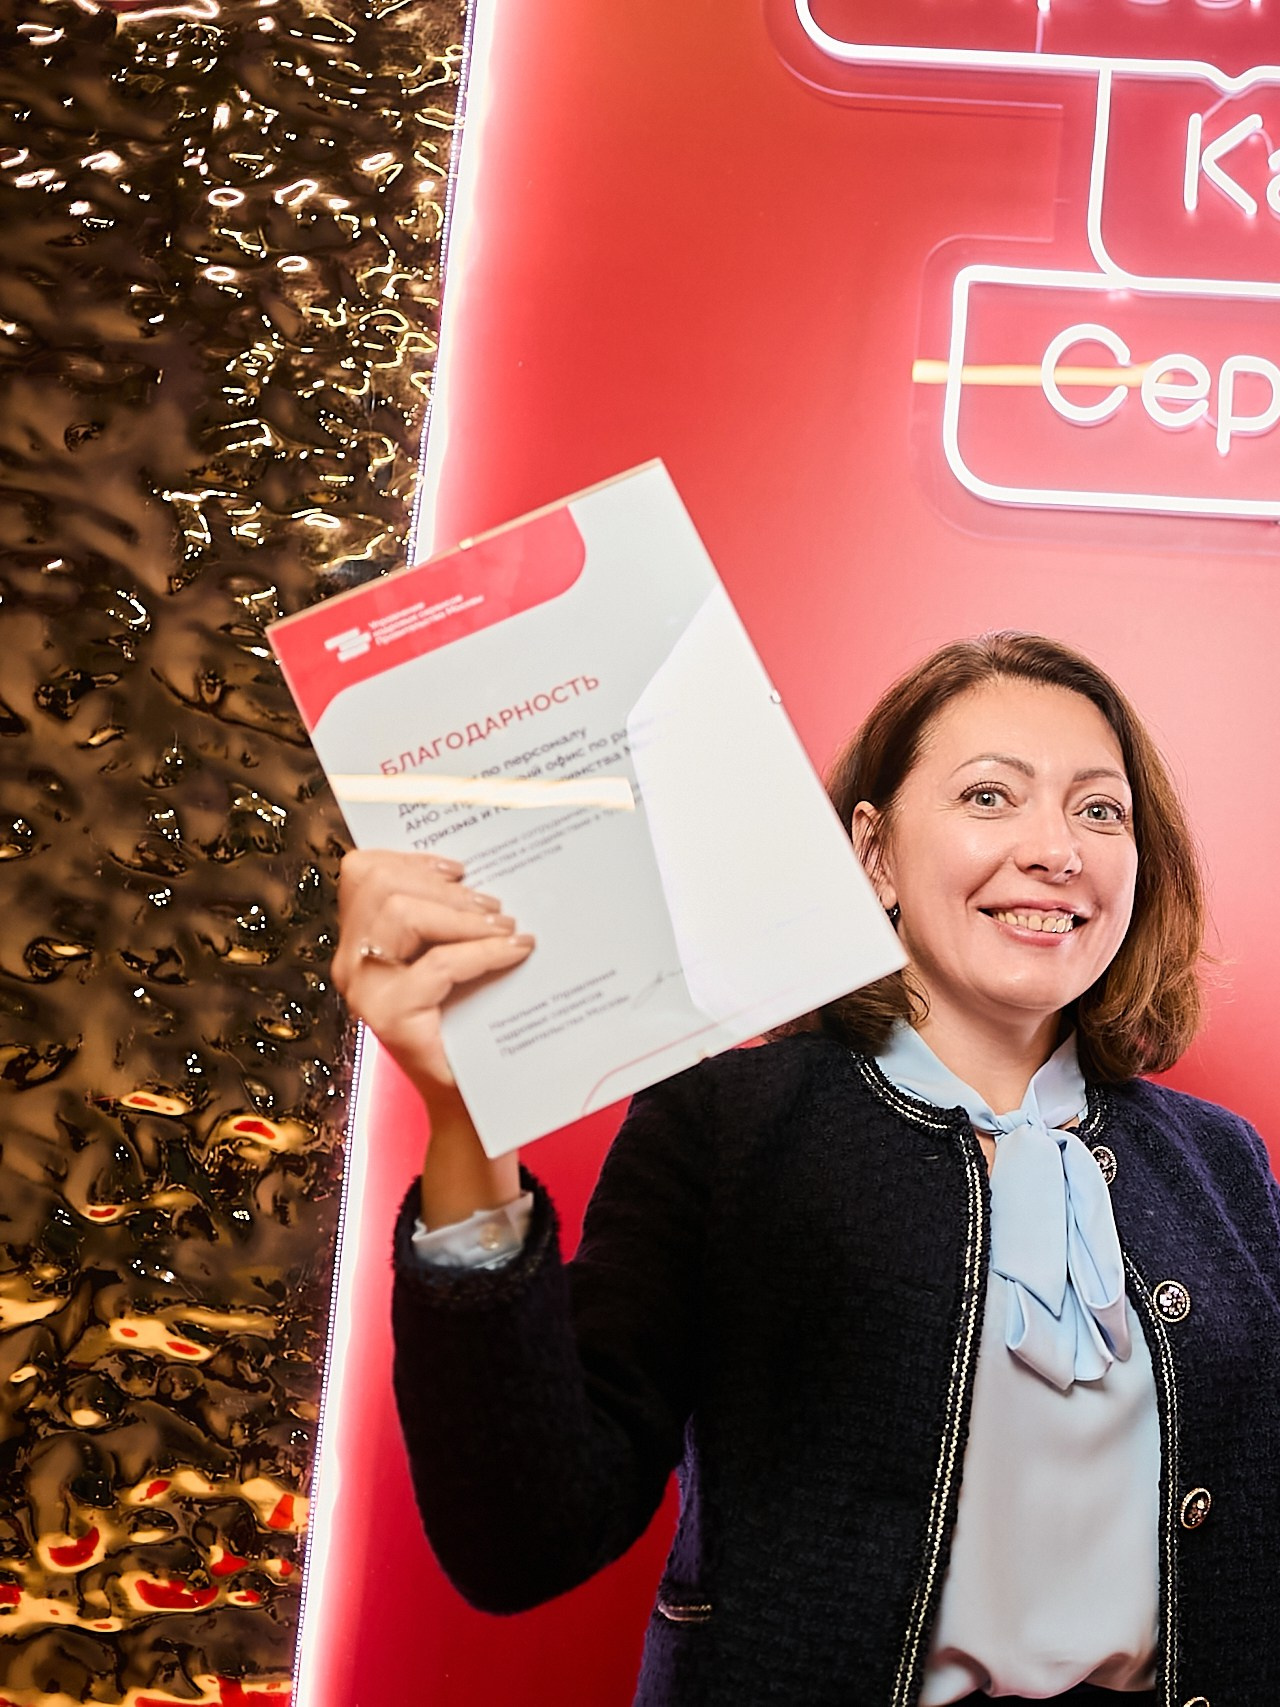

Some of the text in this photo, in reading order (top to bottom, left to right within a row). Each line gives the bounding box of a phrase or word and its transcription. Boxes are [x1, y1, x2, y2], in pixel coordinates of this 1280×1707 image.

[379, 674, 600, 778] БЛАГОДАРНОСТЬ
[503, 727, 587, 770] персоналу
[404, 809, 441, 834] АНО
[545, 750, 585, 773] офис
[588, 738, 608, 754] по
[411, 816, 479, 851] туризма
